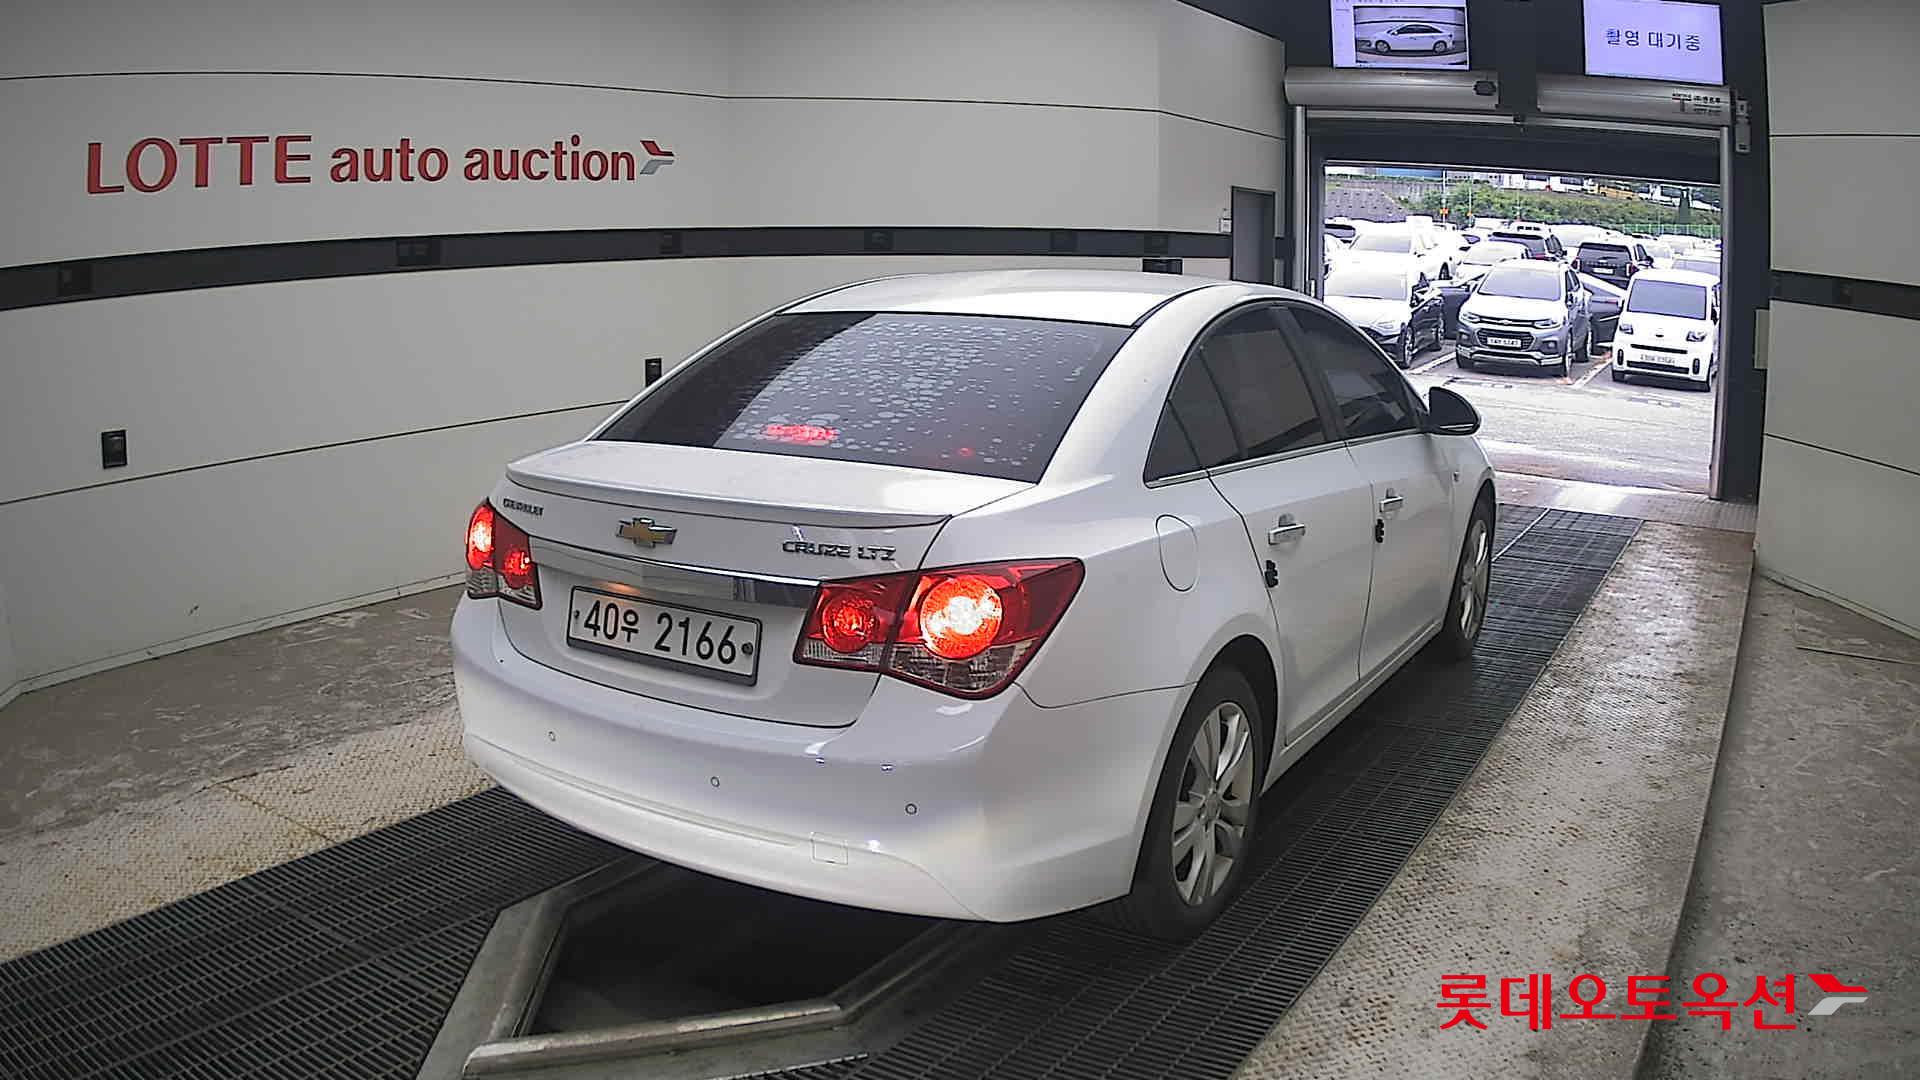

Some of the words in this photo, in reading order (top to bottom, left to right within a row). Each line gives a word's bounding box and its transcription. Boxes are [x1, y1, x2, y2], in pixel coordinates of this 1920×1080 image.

[86, 134, 312, 195] LOTTE
[329, 138, 449, 183] auto
[462, 134, 636, 182] auction
[782, 541, 852, 558] CRUZE
[857, 545, 897, 561] LTZ
[583, 599, 640, 643] 40우
[654, 611, 737, 665] 2166
